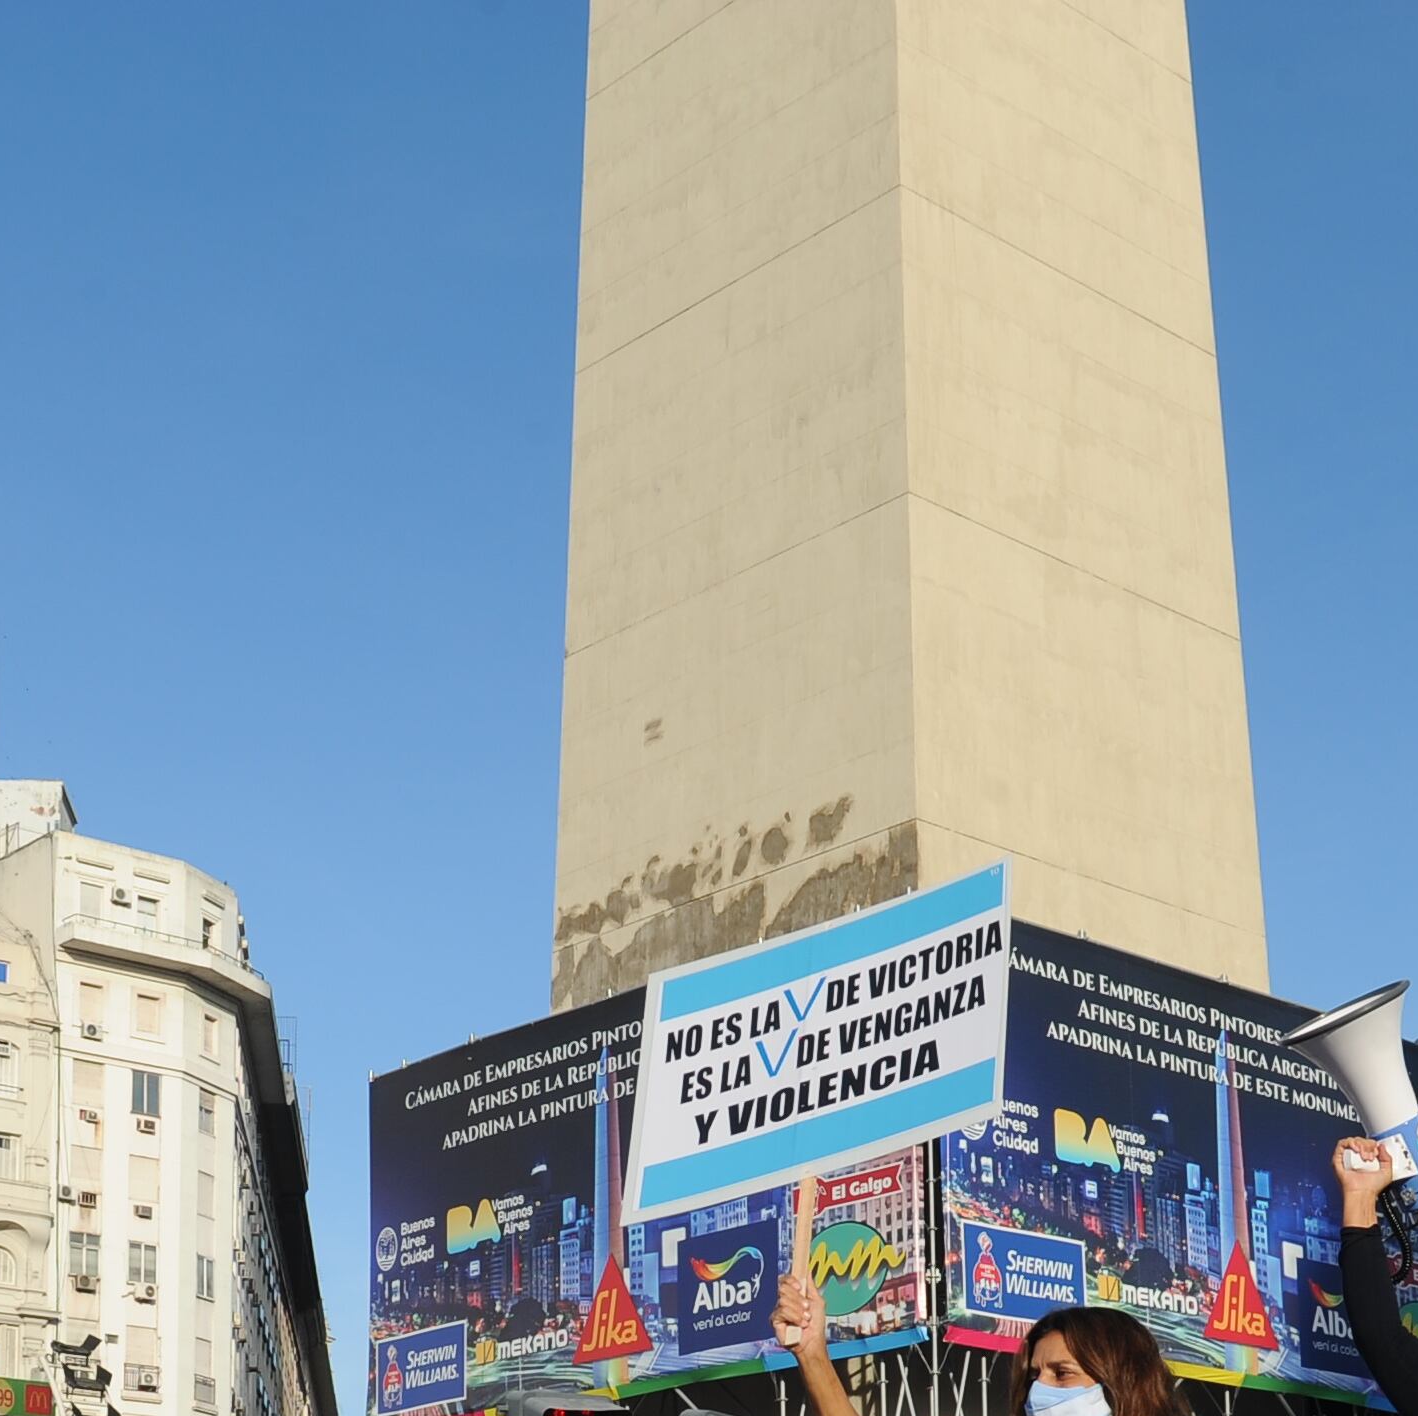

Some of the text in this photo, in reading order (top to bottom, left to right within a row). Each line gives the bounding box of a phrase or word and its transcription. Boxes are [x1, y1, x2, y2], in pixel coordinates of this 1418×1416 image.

[665, 920, 1003, 1064] NO ES LA V DE VICTORIA
[1073, 970, 1096, 991] DE
[1099, 975, 1207, 1024] EMPRESARIOS
[1210, 1007, 1282, 1047] PINTORES
[1078, 999, 1136, 1032] AFINES
[1139, 1018, 1161, 1039] DE
[1164, 1025, 1184, 1046] LA
[681, 974, 986, 1104] ES LA V DE VENGANZA
[405, 1078, 461, 1110] CÁMARA
[463, 1071, 483, 1091] DE
[485, 1037, 589, 1083] EMPRESARIOS
[1046, 1021, 1133, 1061] APADRINA
[1137, 1044, 1158, 1065] LA
[1160, 1051, 1230, 1087] PINTURA
[1232, 1069, 1254, 1092] DE
[1256, 1077, 1290, 1104] ESTE
[468, 1088, 518, 1117] AFINES
[521, 1079, 541, 1099] DE
[545, 1072, 564, 1093] LA
[695, 1039, 940, 1145] Y VIOLENCIA
[443, 1078, 635, 1151] APADRINA LA PINTURA DE
[993, 1130, 1039, 1154] Ciudad
[1109, 1123, 1146, 1146] Vamos
[1116, 1140, 1156, 1163] Buenos
[1123, 1157, 1154, 1176] Aires
[492, 1194, 525, 1212] Vamos
[832, 1174, 893, 1201] El Galgo
[400, 1215, 436, 1235] Buenos
[497, 1203, 534, 1225] Buenos
[503, 1219, 531, 1236] Aires
[400, 1234, 427, 1252] Aires
[400, 1245, 435, 1268] Ciudad
[1006, 1250, 1074, 1281] SHERWIN
[692, 1279, 752, 1314] Alba
[1123, 1285, 1199, 1316] MEKANO
[1213, 1273, 1266, 1337] Sika
[582, 1287, 638, 1353] Sika
[726, 1309, 752, 1325] color
[406, 1343, 458, 1370] SHERWIN
[497, 1329, 569, 1360] MEKANO
